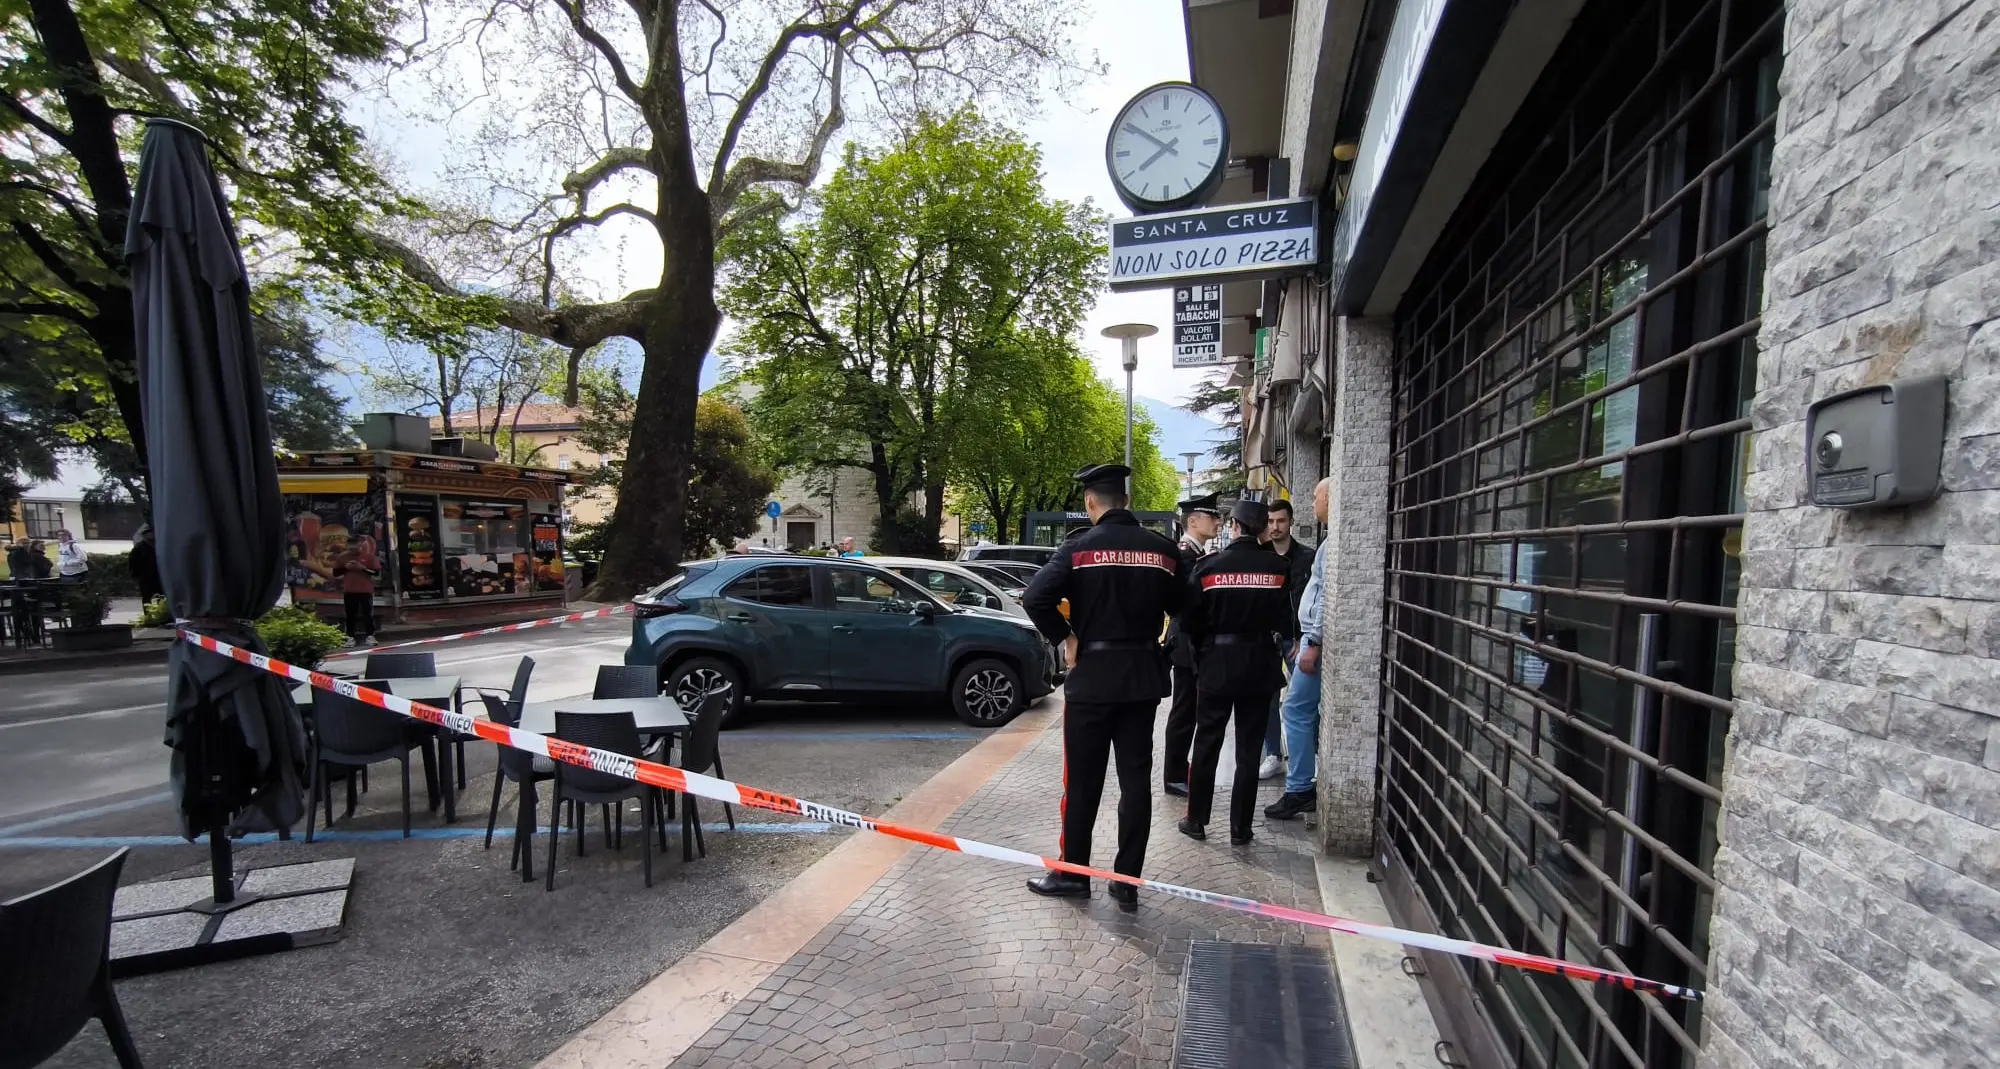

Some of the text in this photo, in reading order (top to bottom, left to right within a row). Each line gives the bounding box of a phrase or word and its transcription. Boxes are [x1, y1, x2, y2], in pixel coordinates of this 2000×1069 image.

[1133, 210, 1288, 239] SANTA CRUZ
[1114, 237, 1311, 276] NON SOLO PIZZA
[1175, 309, 1219, 322] TABACCHI
[1183, 325, 1212, 335] VALORI
[1180, 333, 1214, 343] BOLLATI
[1178, 344, 1216, 355] LOTTO
[1066, 511, 1090, 519] TERRAZZ
[1093, 551, 1163, 566] CARABINIERI
[1214, 574, 1277, 585] CARABINIERI
